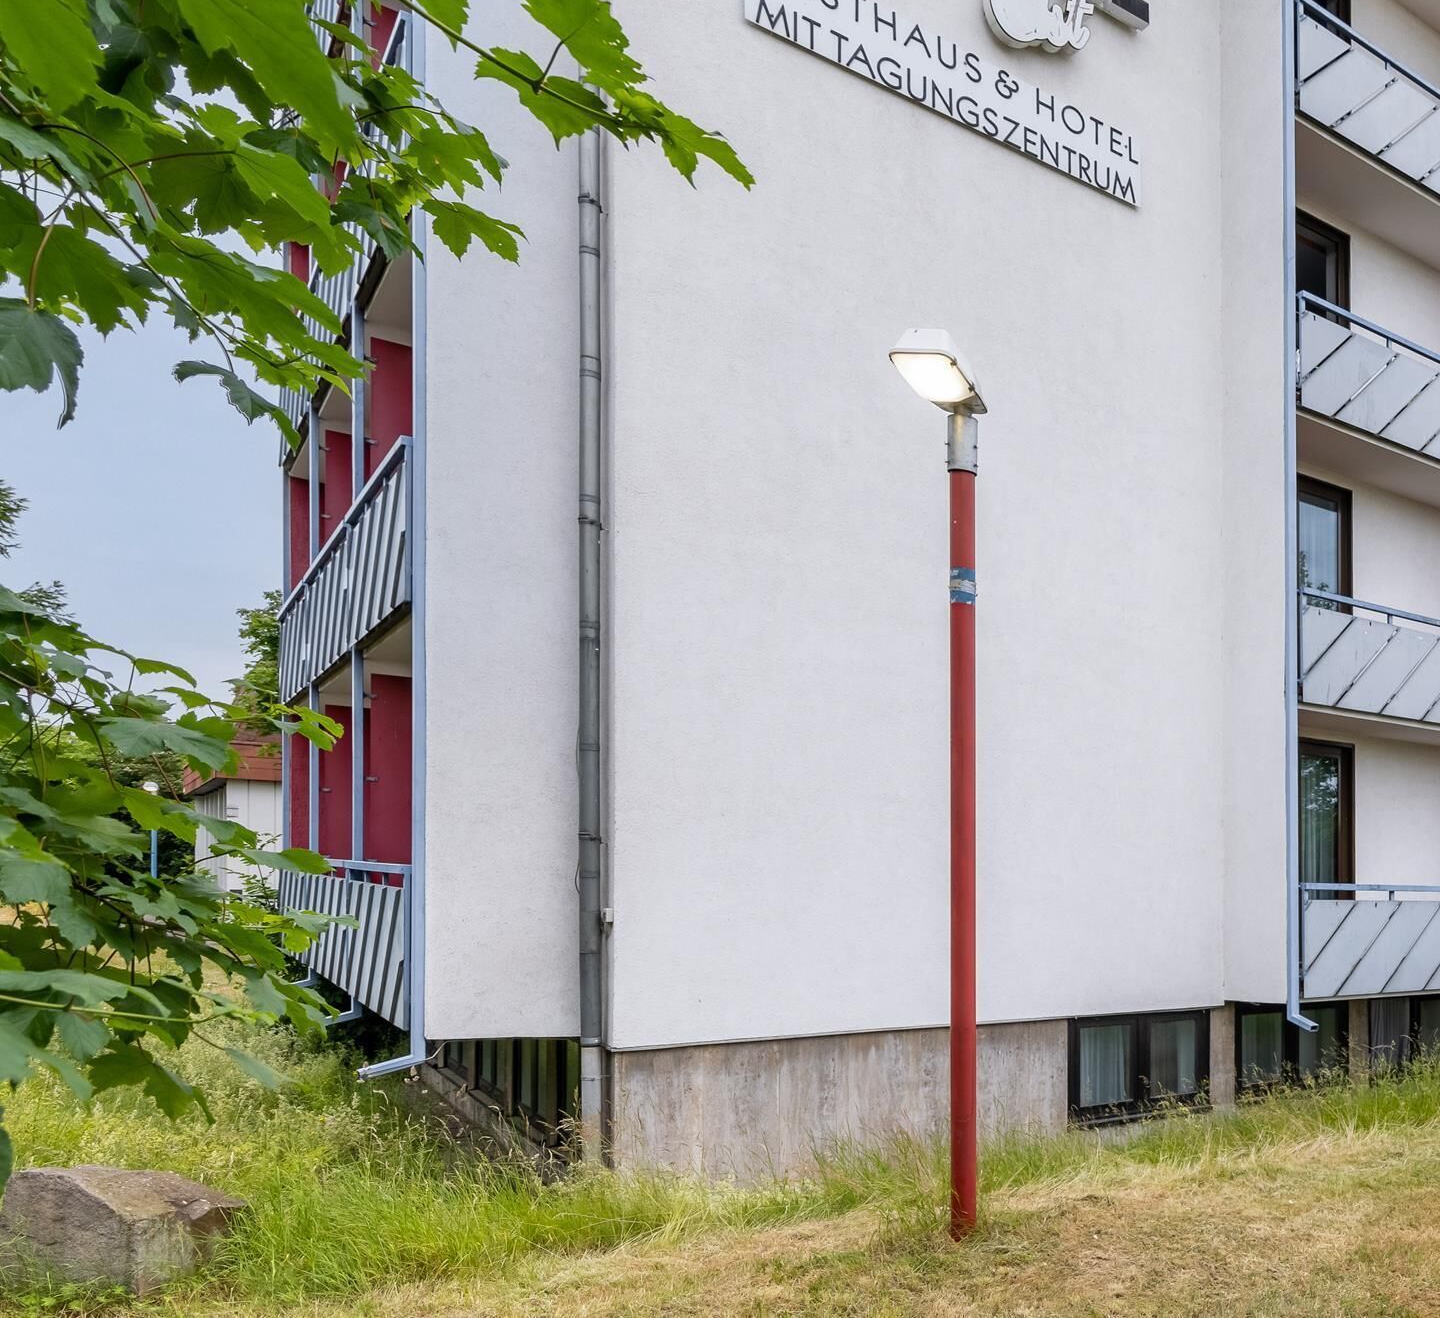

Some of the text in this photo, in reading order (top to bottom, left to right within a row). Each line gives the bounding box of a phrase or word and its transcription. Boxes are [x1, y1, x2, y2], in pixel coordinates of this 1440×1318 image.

[830, 29, 1137, 204] TAGUNGSZENTRUM
[994, 68, 1019, 99] &
[1036, 87, 1139, 166] HOTEL
